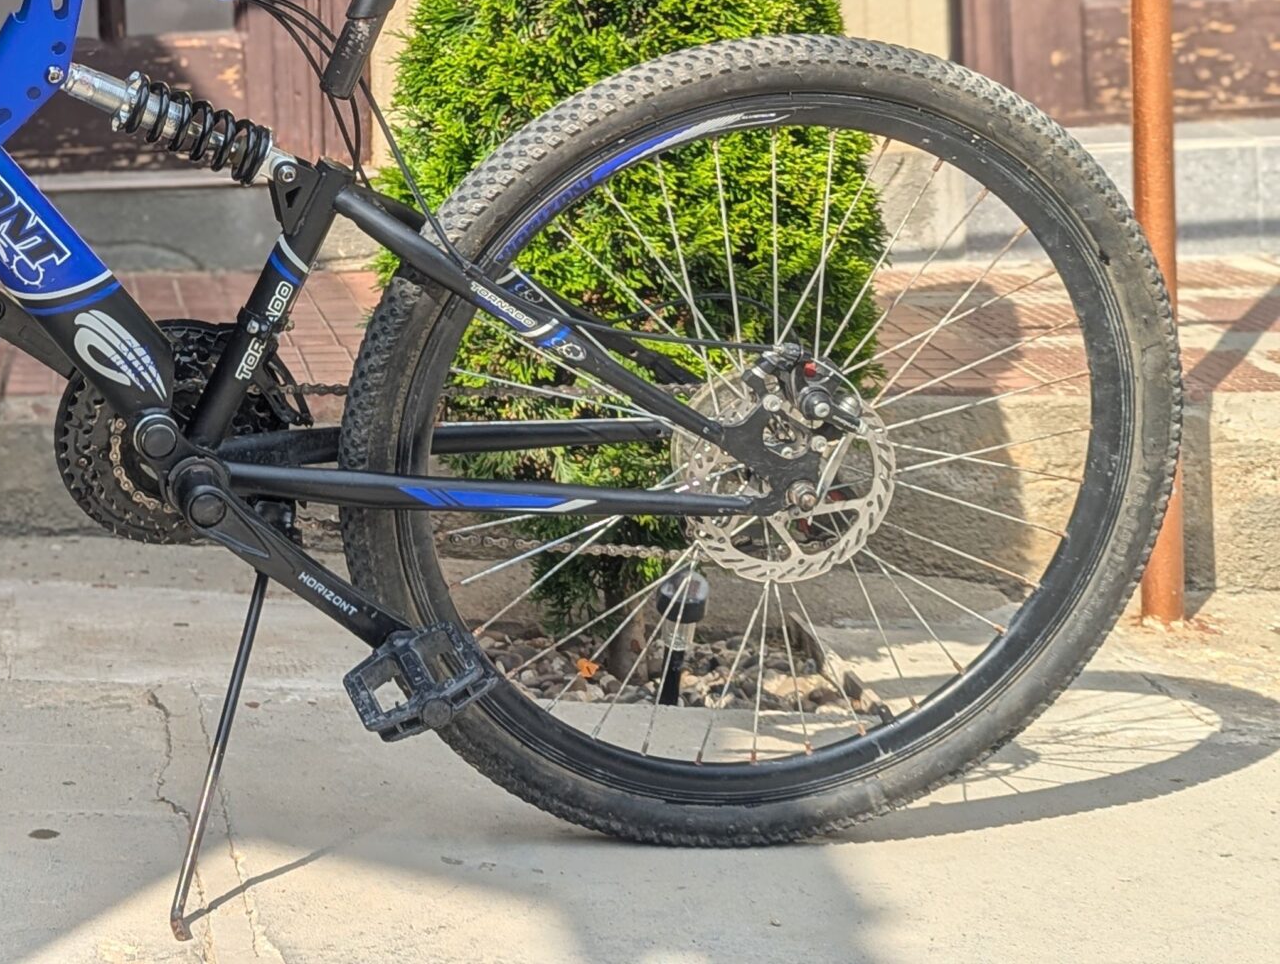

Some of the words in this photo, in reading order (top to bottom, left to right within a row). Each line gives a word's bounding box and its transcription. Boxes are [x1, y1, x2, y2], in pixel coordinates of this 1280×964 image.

[470, 280, 537, 328] TORNADO
[235, 280, 294, 380] TORADO
[298, 571, 358, 616] HORIZONT
